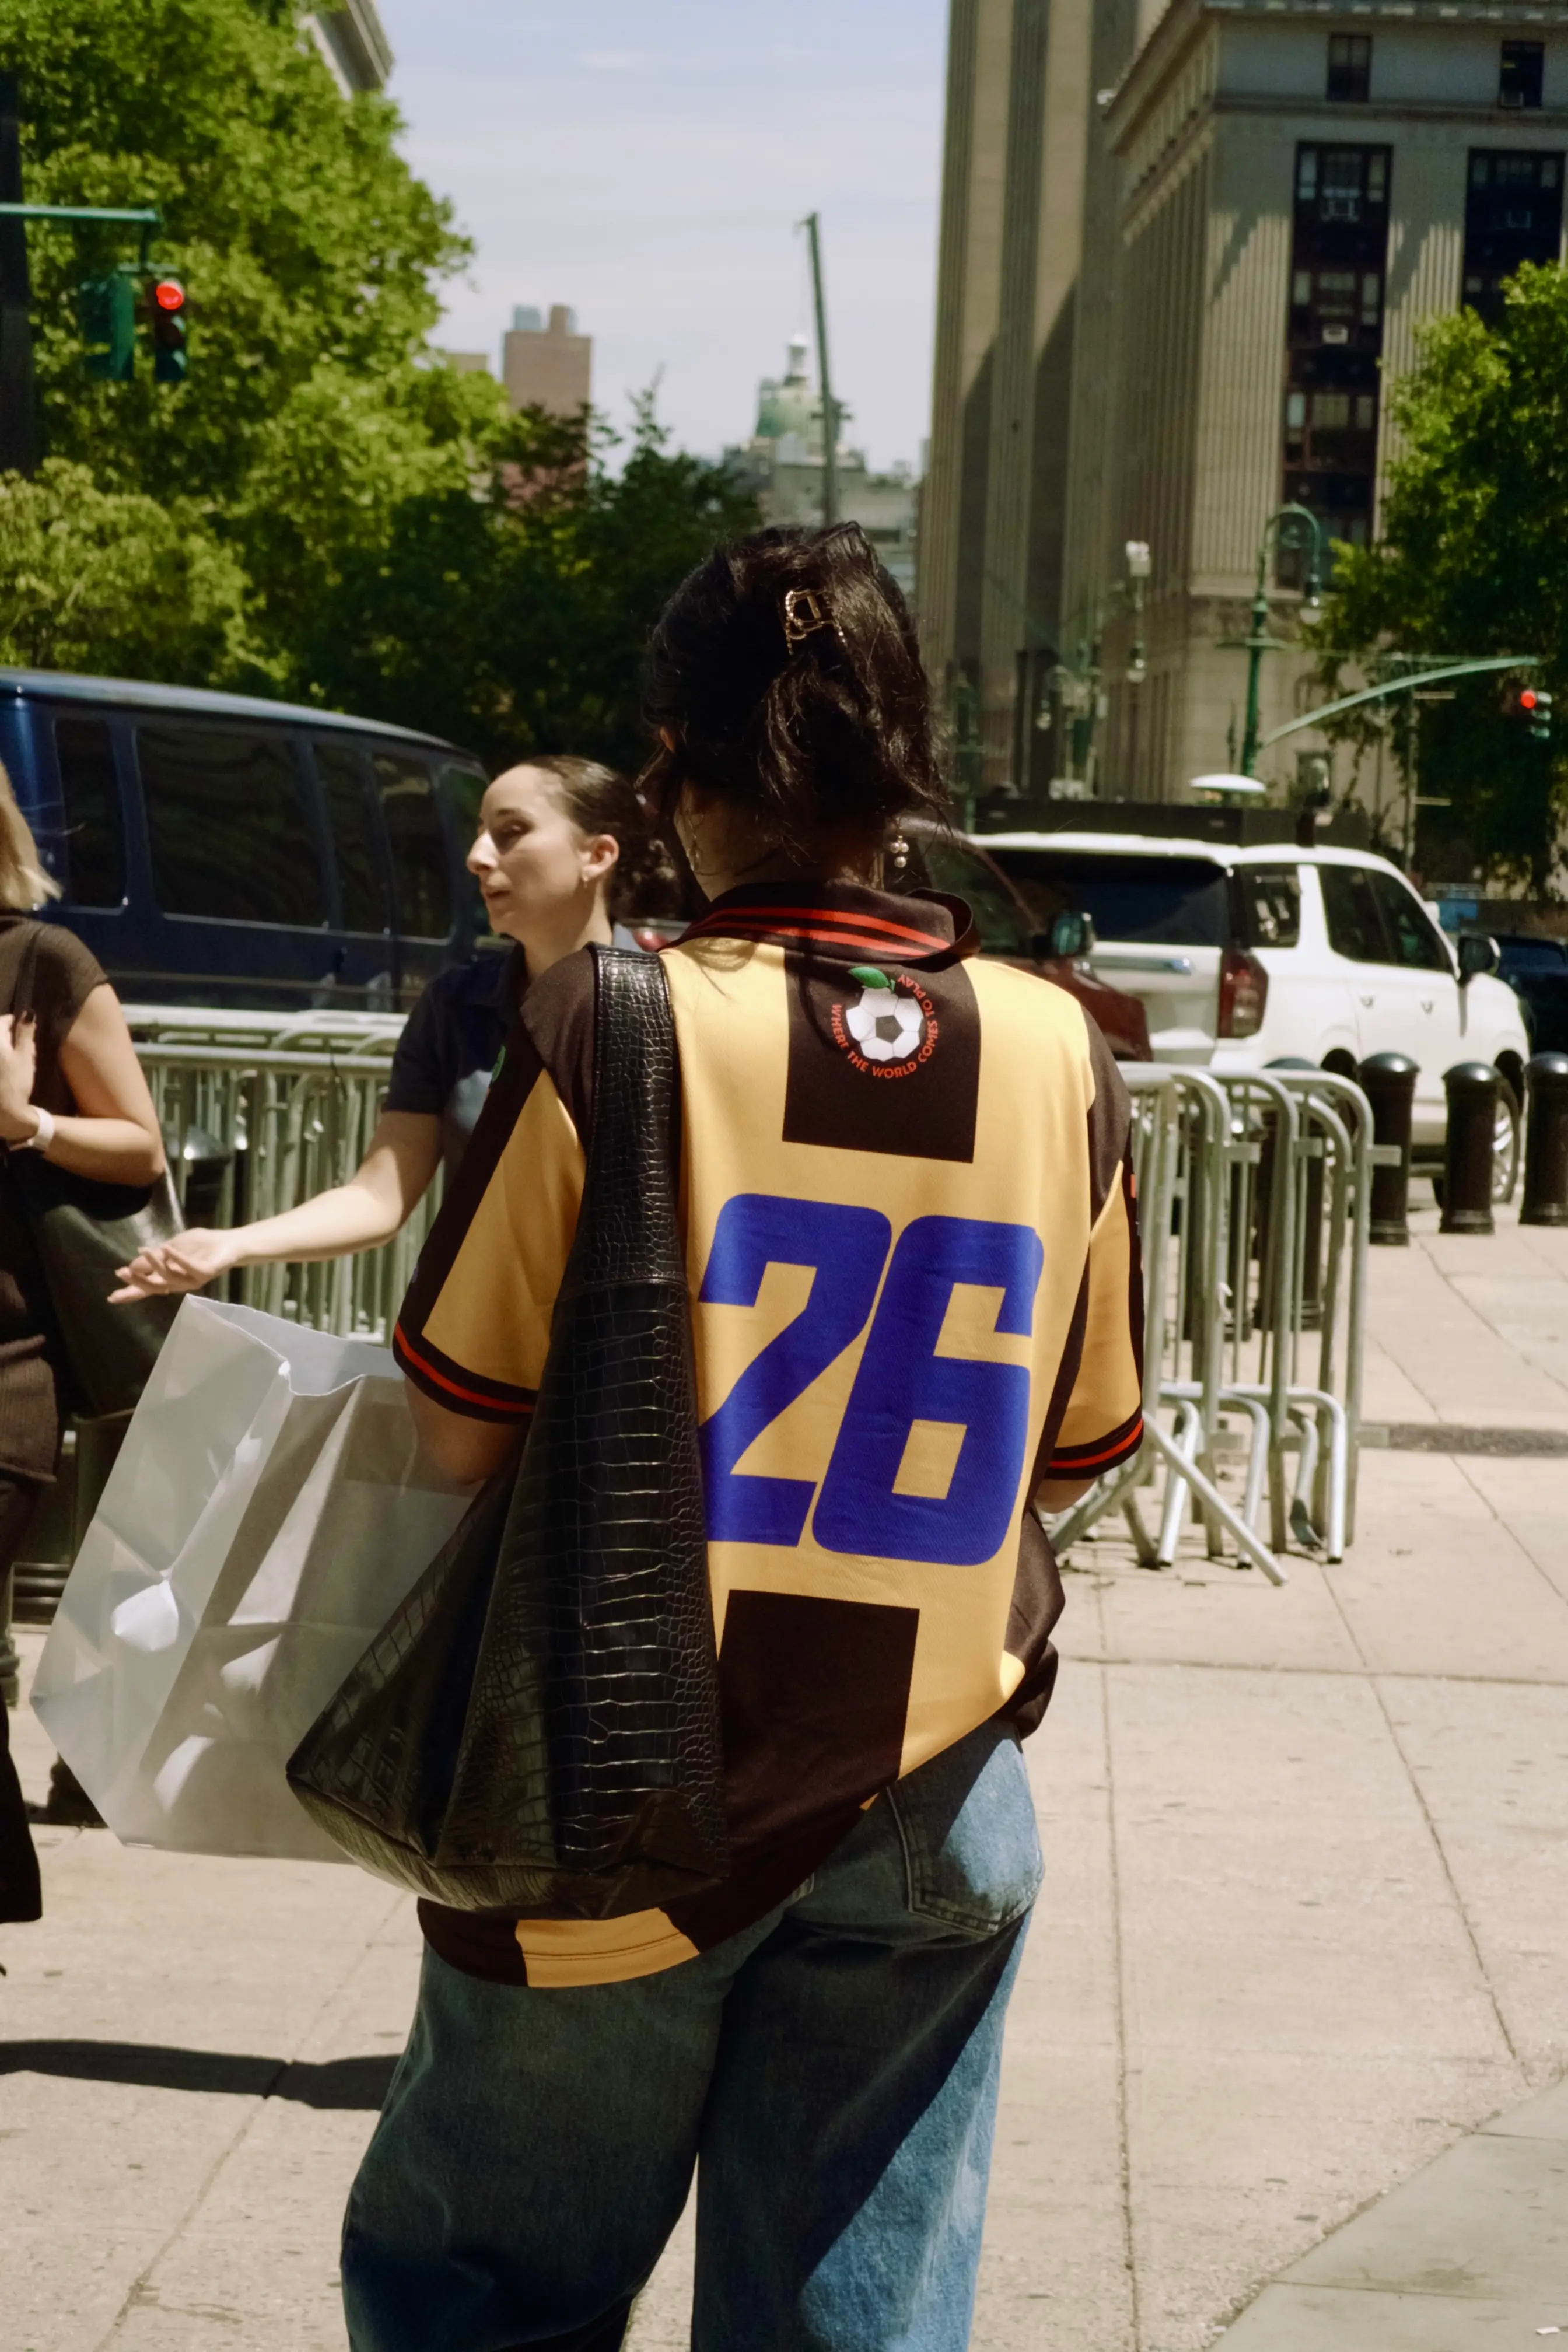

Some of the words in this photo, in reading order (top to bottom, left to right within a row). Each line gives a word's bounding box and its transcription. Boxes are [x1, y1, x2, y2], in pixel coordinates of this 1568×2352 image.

[898, 974, 926, 999] PLAY
[922, 1000, 935, 1017] TO
[831, 1004, 849, 1049] WHERE
[918, 1020, 938, 1062] COMES
[847, 1051, 869, 1072] THE
[872, 1062, 917, 1079] WORLD
[698, 1194, 1044, 1566] 26
